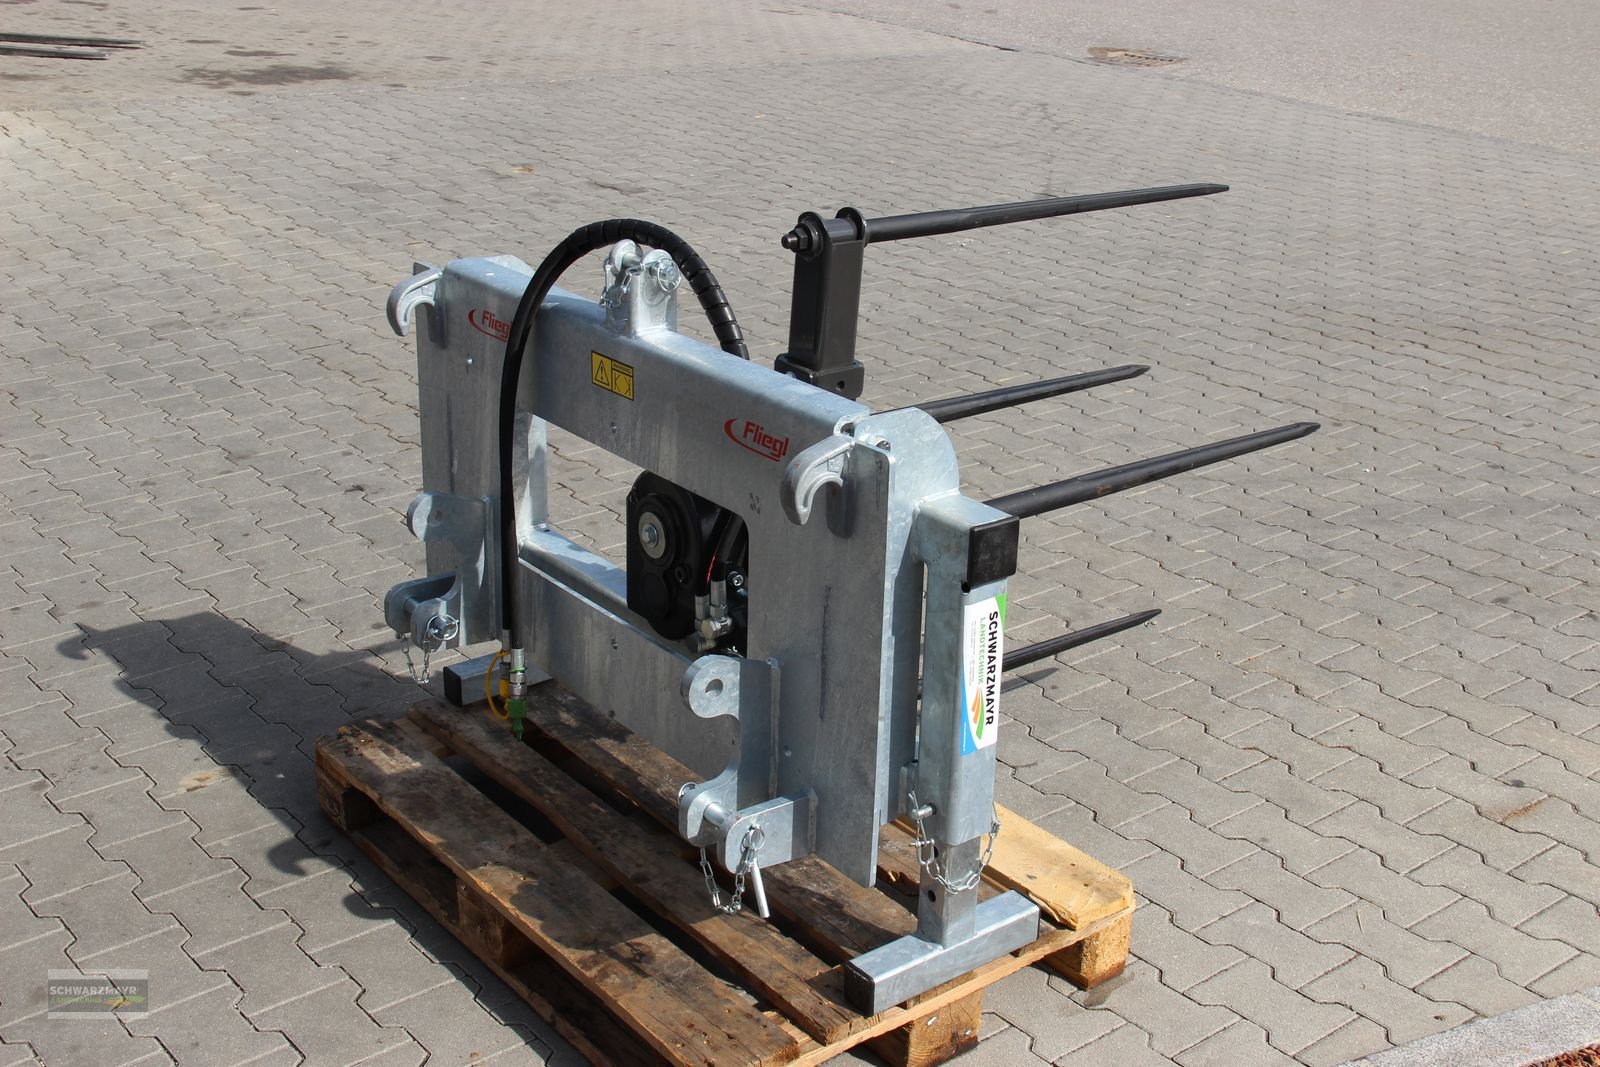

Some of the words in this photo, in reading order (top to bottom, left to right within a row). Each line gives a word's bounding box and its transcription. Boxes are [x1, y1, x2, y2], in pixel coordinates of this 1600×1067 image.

[742, 420, 790, 459] Fliegl
[977, 616, 987, 685] LANDTECHNIK
[985, 611, 999, 726] SCHWARZMAYR
